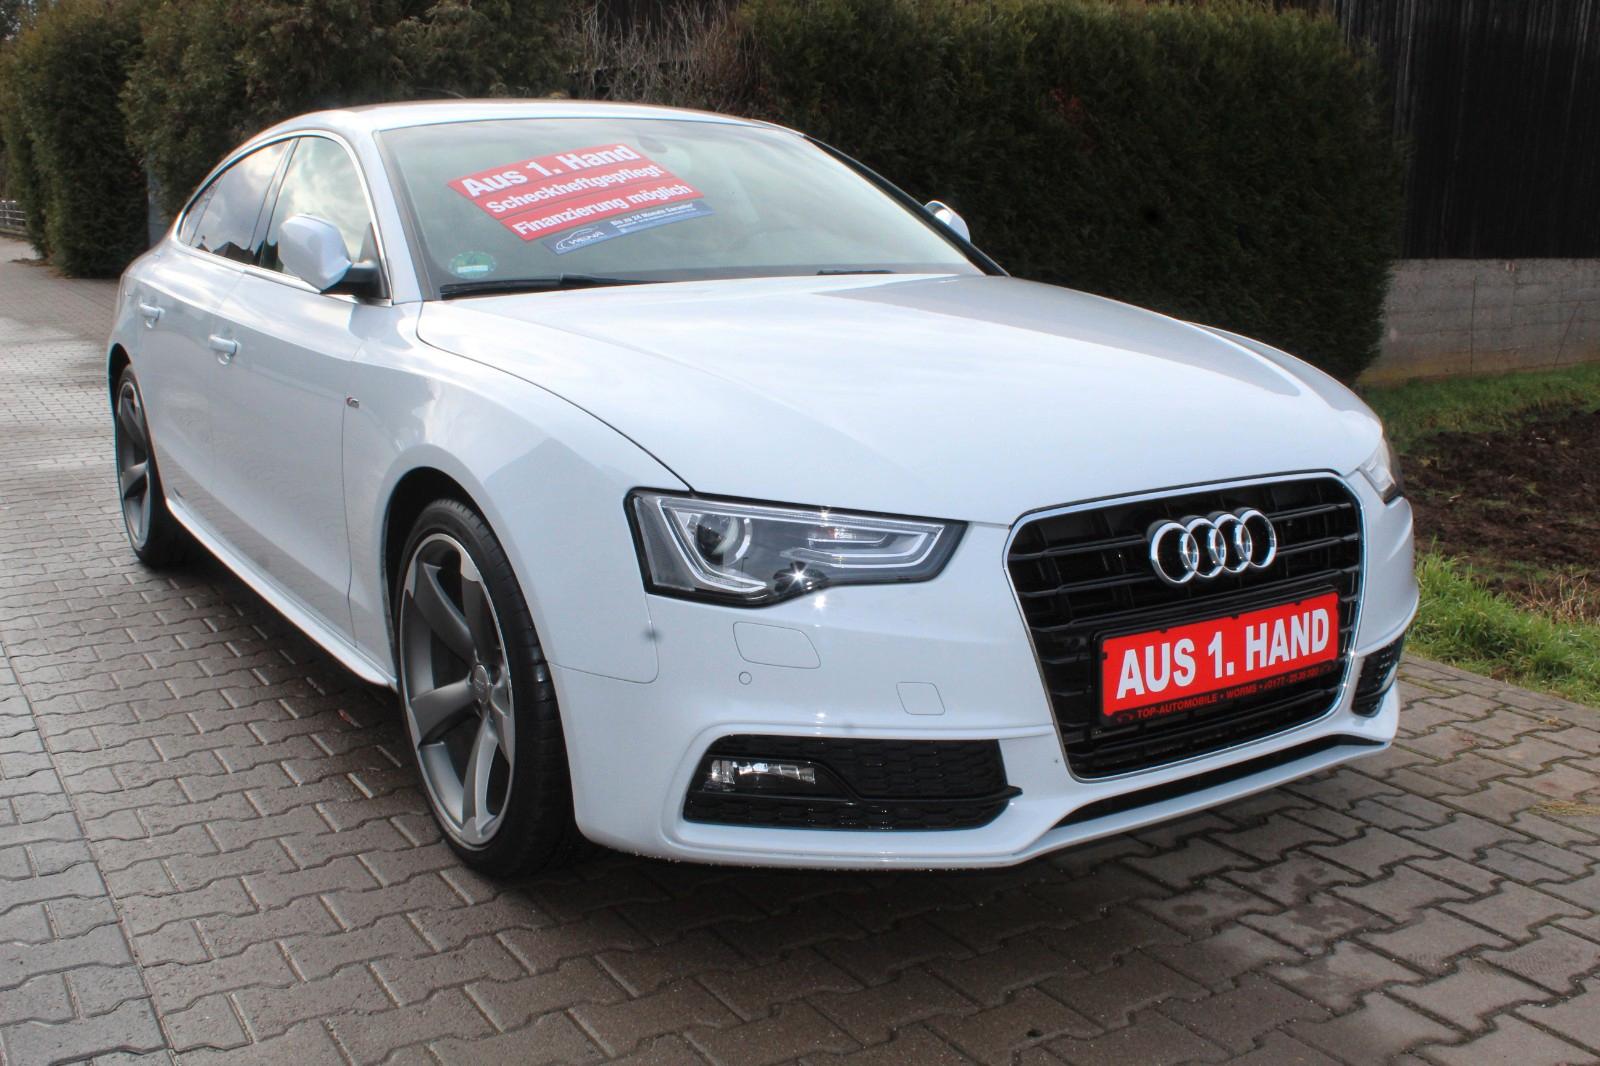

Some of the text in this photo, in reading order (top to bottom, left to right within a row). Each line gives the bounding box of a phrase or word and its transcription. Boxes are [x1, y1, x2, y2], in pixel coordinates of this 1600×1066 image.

[462, 144, 641, 197] Aus 1. Hand
[486, 164, 665, 213] Scheckheftgepflegt
[511, 198, 630, 236] Finanzierung
[629, 183, 693, 206] möglich
[1116, 608, 1330, 700] AUS 1. HAND
[1136, 694, 1218, 719] TOP-AUTOMOBILE
[1225, 684, 1258, 699] WORMS
